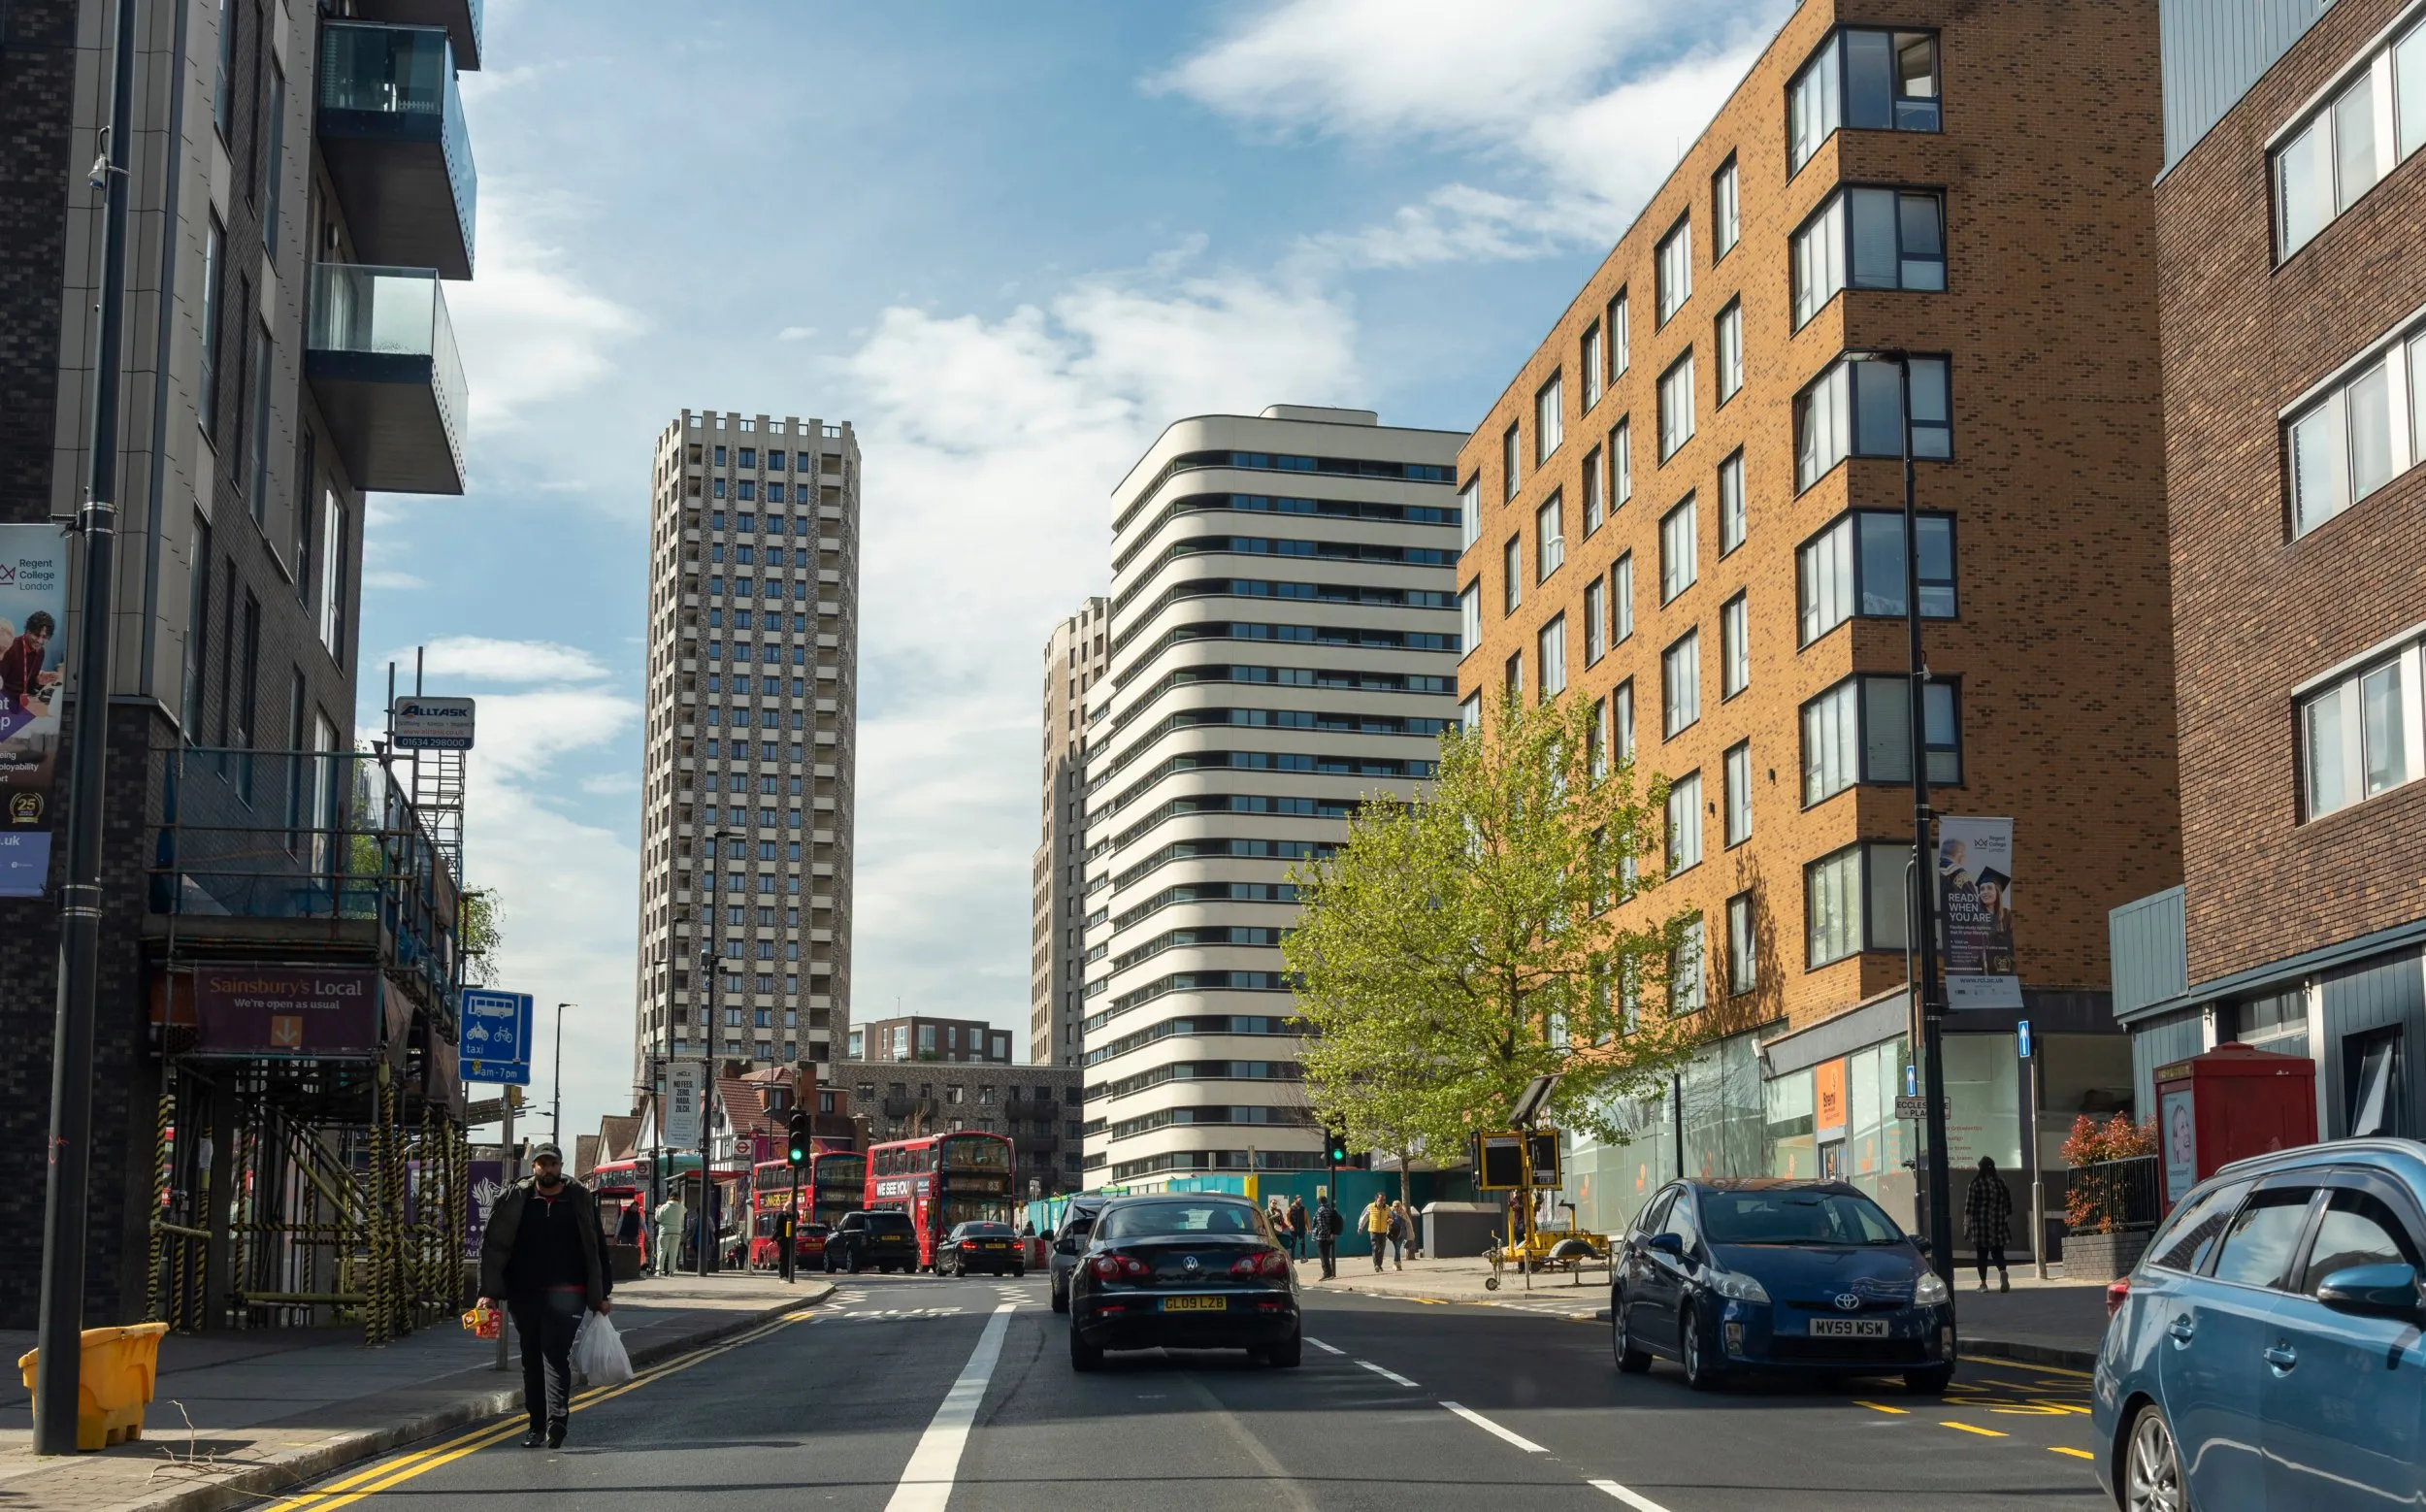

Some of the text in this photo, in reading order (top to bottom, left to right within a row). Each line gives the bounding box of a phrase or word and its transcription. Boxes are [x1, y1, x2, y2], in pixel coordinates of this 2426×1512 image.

[19, 559, 52, 569] Regent
[19, 571, 55, 580] College
[19, 582, 53, 591] London
[400, 705, 468, 717] ALLTASK
[430, 739, 465, 747] 298000
[17, 799, 36, 810] 25
[1948, 893, 1981, 903] READY
[1949, 904, 1979, 912] WHEN
[1950, 913, 1992, 922] YOU ARE
[210, 977, 311, 998] Sainsbury's
[314, 980, 363, 996] Local
[234, 999, 265, 1008] We're
[267, 1001, 293, 1010] open
[311, 1000, 340, 1009] usual
[466, 1044, 484, 1054] taxi
[676, 1088, 691, 1097] ZERO.
[675, 1104, 692, 1113] ZILCH.
[1896, 1101, 1950, 1110] ECCLESE
[876, 1182, 887, 1197] WE
[886, 1181, 898, 1196] SEE
[988, 1181, 1000, 1192] 83
[1165, 1298, 1224, 1309] GL09 LZB
[1816, 1321, 1884, 1335] MV59 WSW
